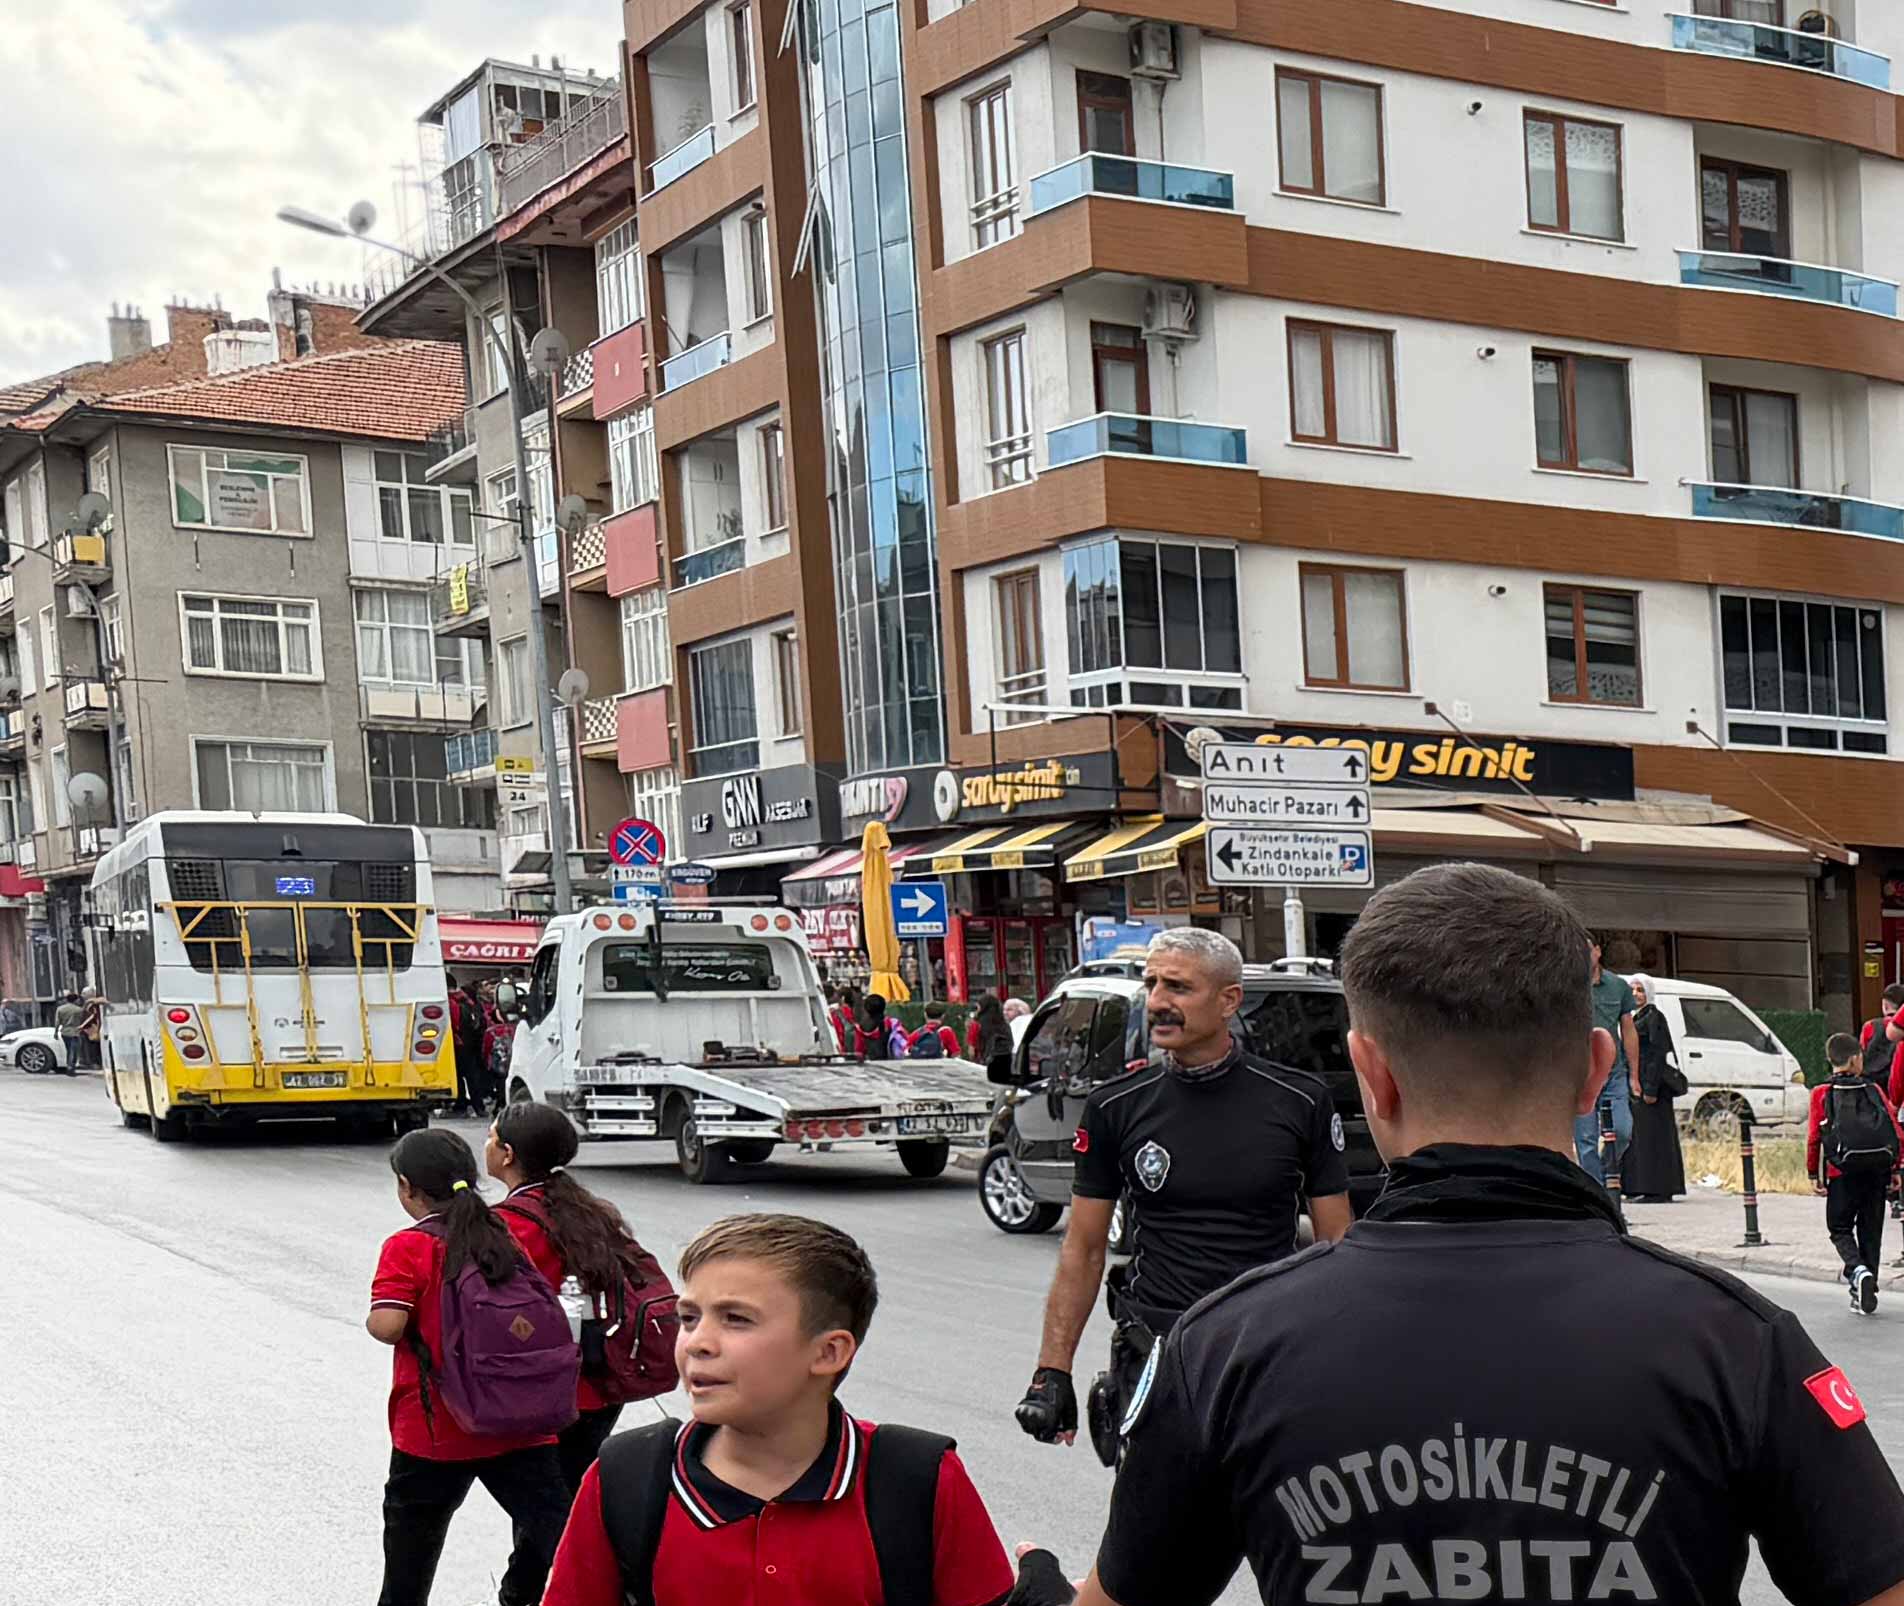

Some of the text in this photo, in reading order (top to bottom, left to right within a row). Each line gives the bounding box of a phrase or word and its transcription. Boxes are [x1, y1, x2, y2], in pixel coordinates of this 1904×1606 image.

[1209, 749, 1285, 775] Anıt
[1408, 737, 1536, 782] simit
[1210, 796, 1338, 817] Muhacir Pazarı
[1248, 846, 1334, 862] Zindankale
[1241, 863, 1274, 876] Katlı
[1274, 1422, 1666, 1543] MOTOSİKLETLİ
[1301, 1538, 1659, 1605] ZABITA
